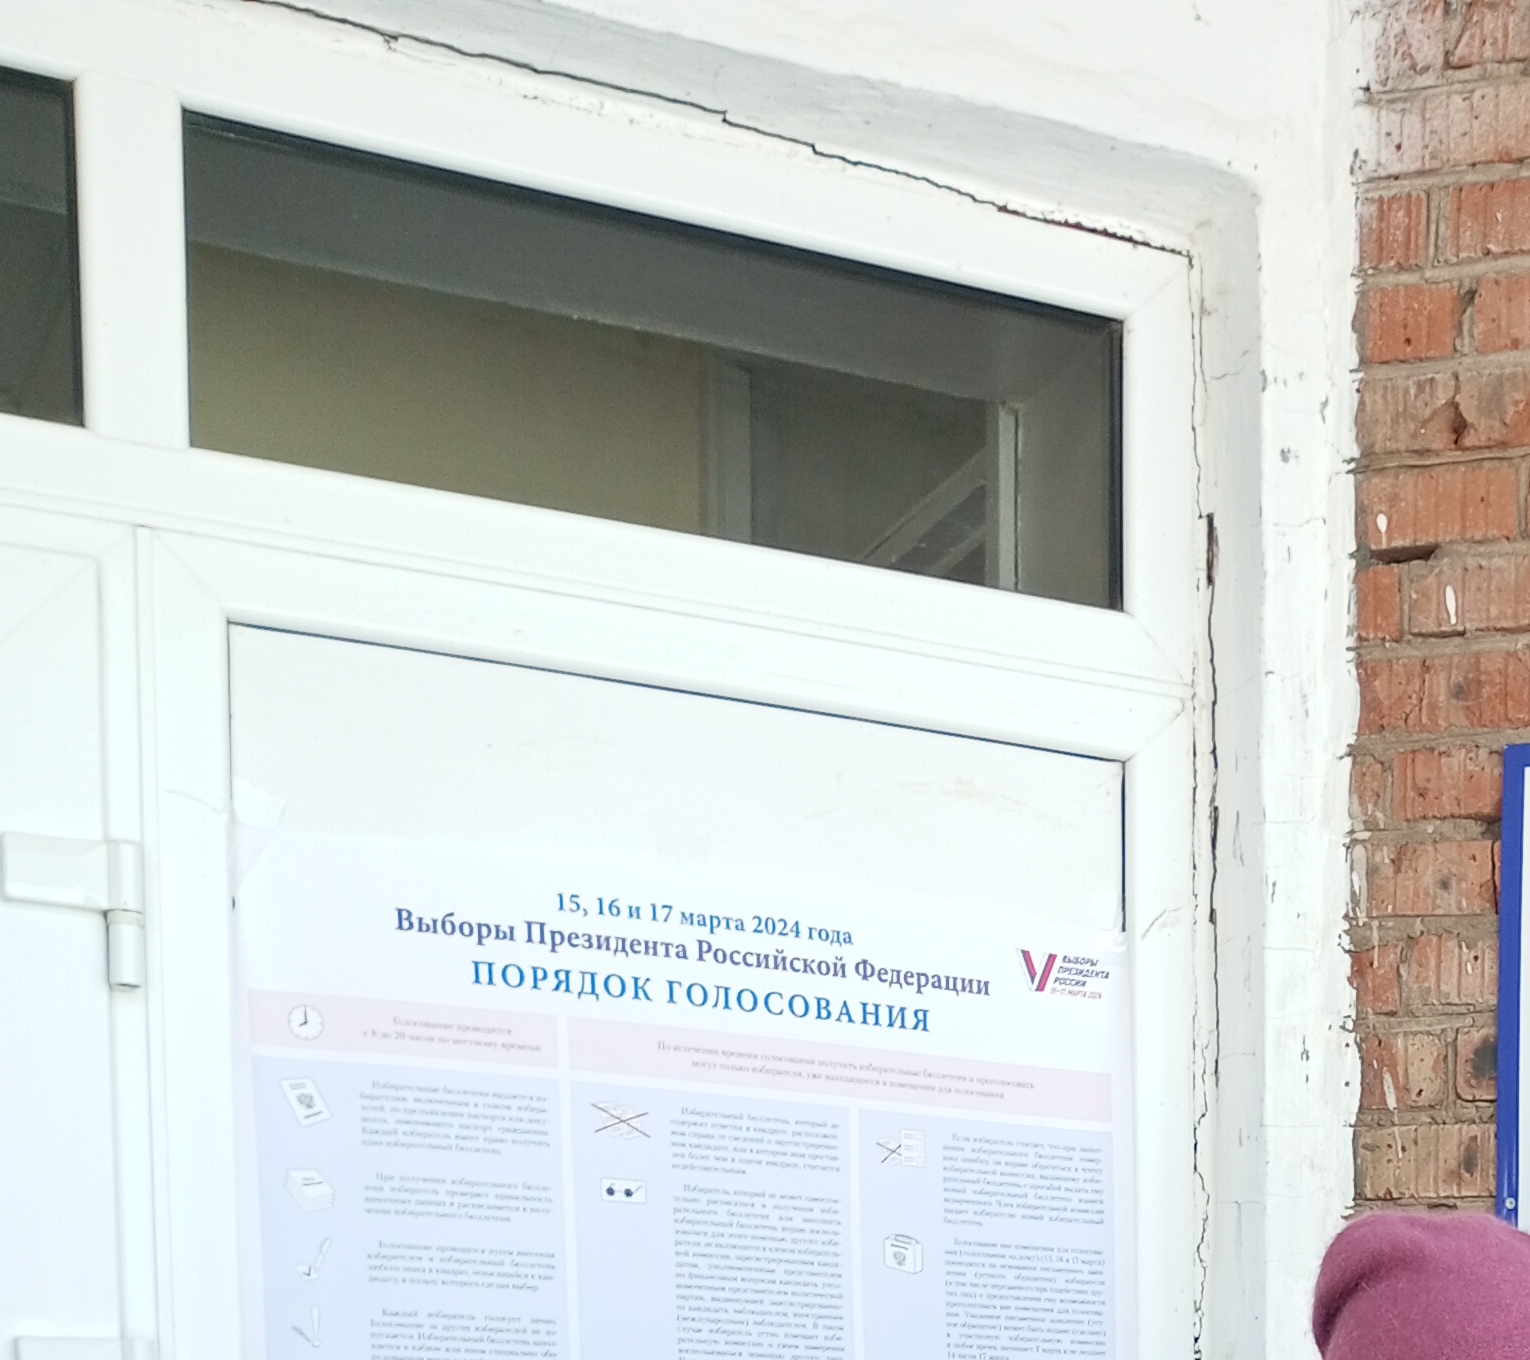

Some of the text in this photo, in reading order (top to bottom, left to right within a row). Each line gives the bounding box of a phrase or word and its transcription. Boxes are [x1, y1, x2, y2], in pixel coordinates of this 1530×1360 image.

[395, 907, 990, 996] Выборы Президента Российской Федерации
[557, 893, 853, 947] 15, 16 и 17 марта 2024 года
[472, 960, 930, 1032] ПОРЯДОК ГОЛОСОВАНИЯ
